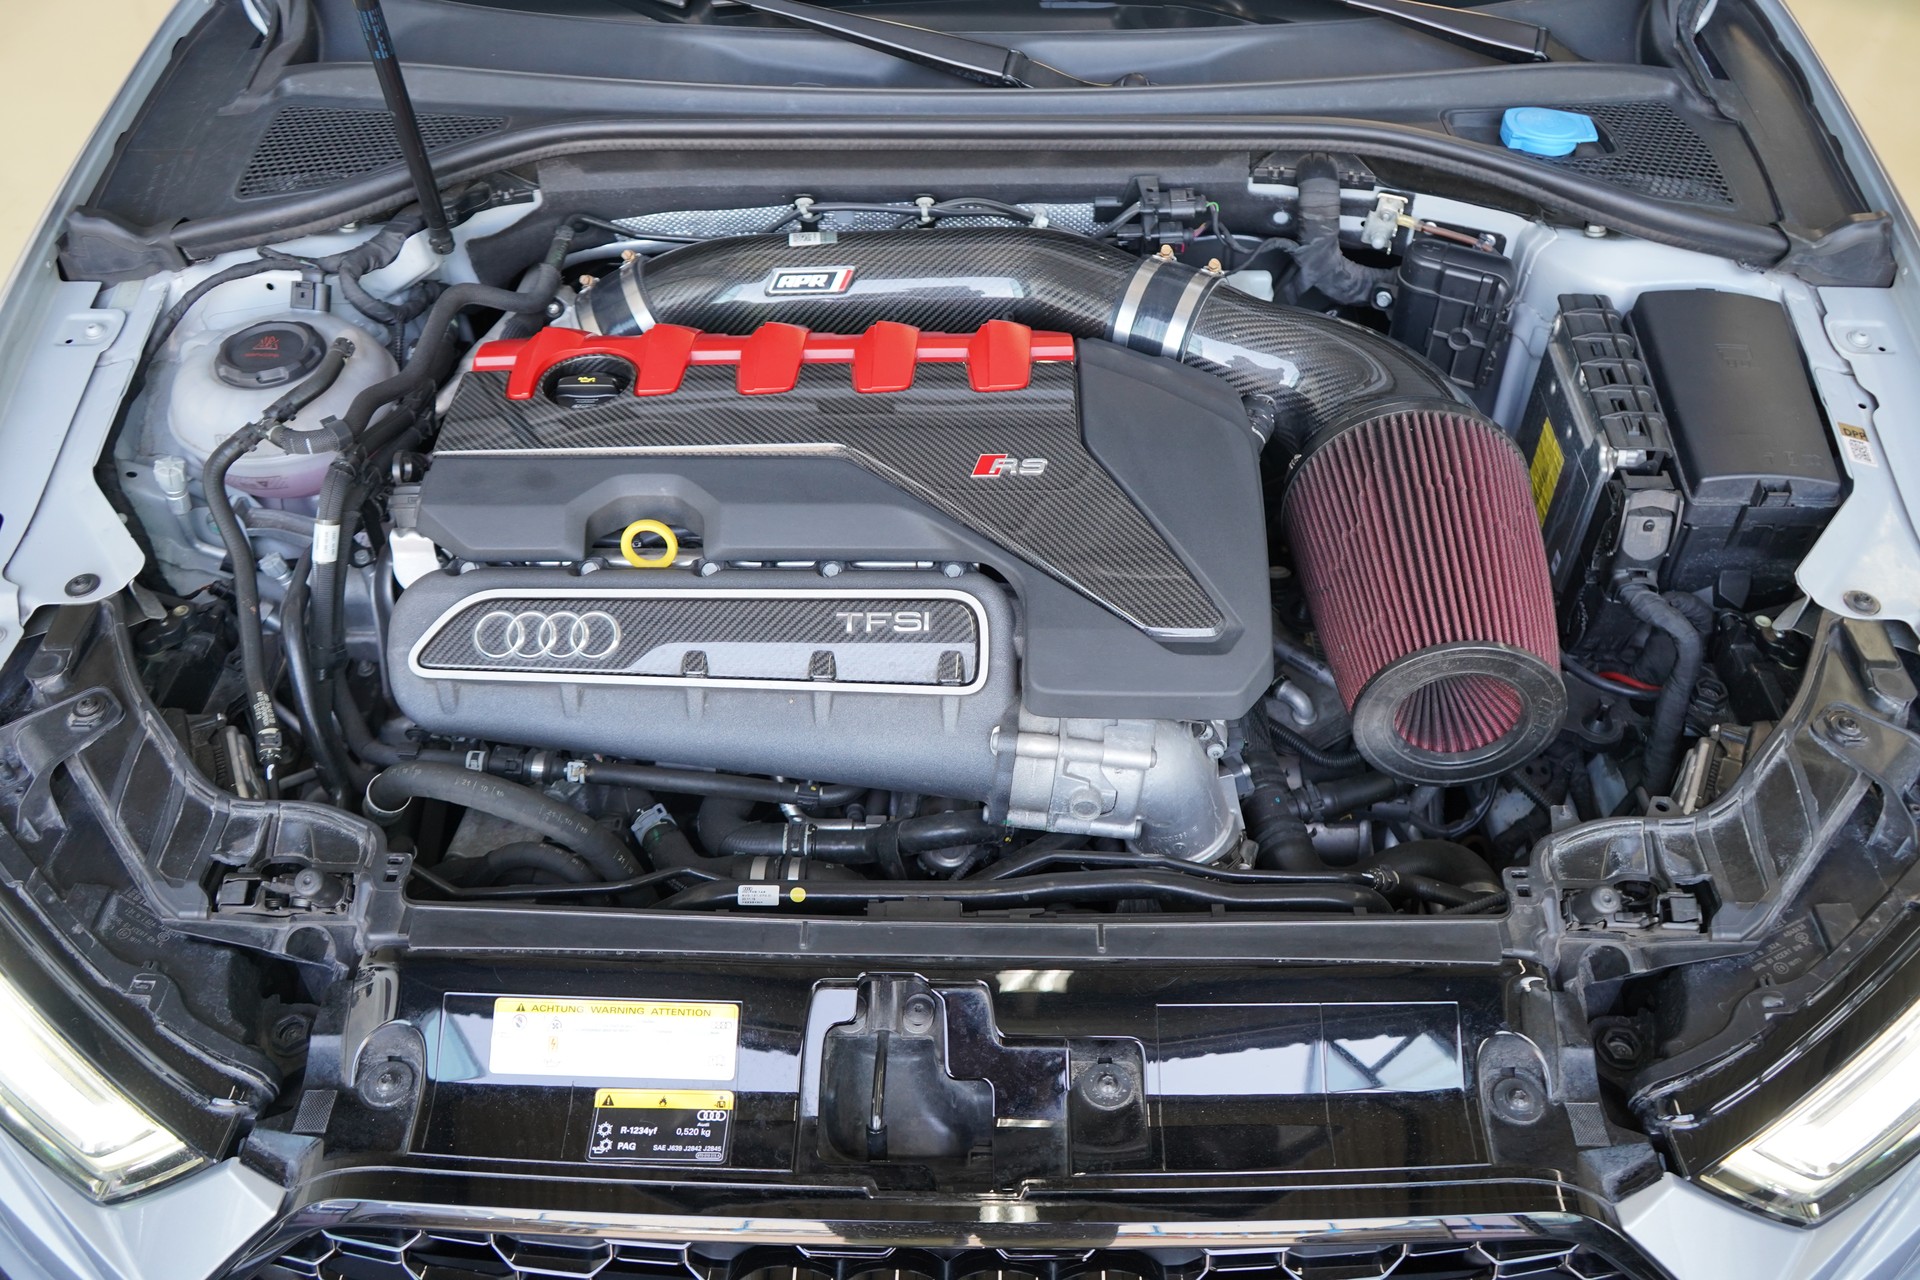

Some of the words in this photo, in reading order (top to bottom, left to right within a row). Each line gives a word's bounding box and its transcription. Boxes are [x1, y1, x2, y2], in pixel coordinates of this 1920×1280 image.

[776, 274, 829, 289] APR
[988, 457, 1048, 476] RS
[836, 611, 930, 633] TFSI
[531, 1005, 584, 1014] ACHTUNG
[590, 1006, 645, 1015] WARNING
[650, 1008, 712, 1017] ATTENTION
[620, 1126, 658, 1136] R-1234yf
[676, 1128, 699, 1136] 0,520
[700, 1127, 711, 1138] kg
[617, 1142, 636, 1151] PAG
